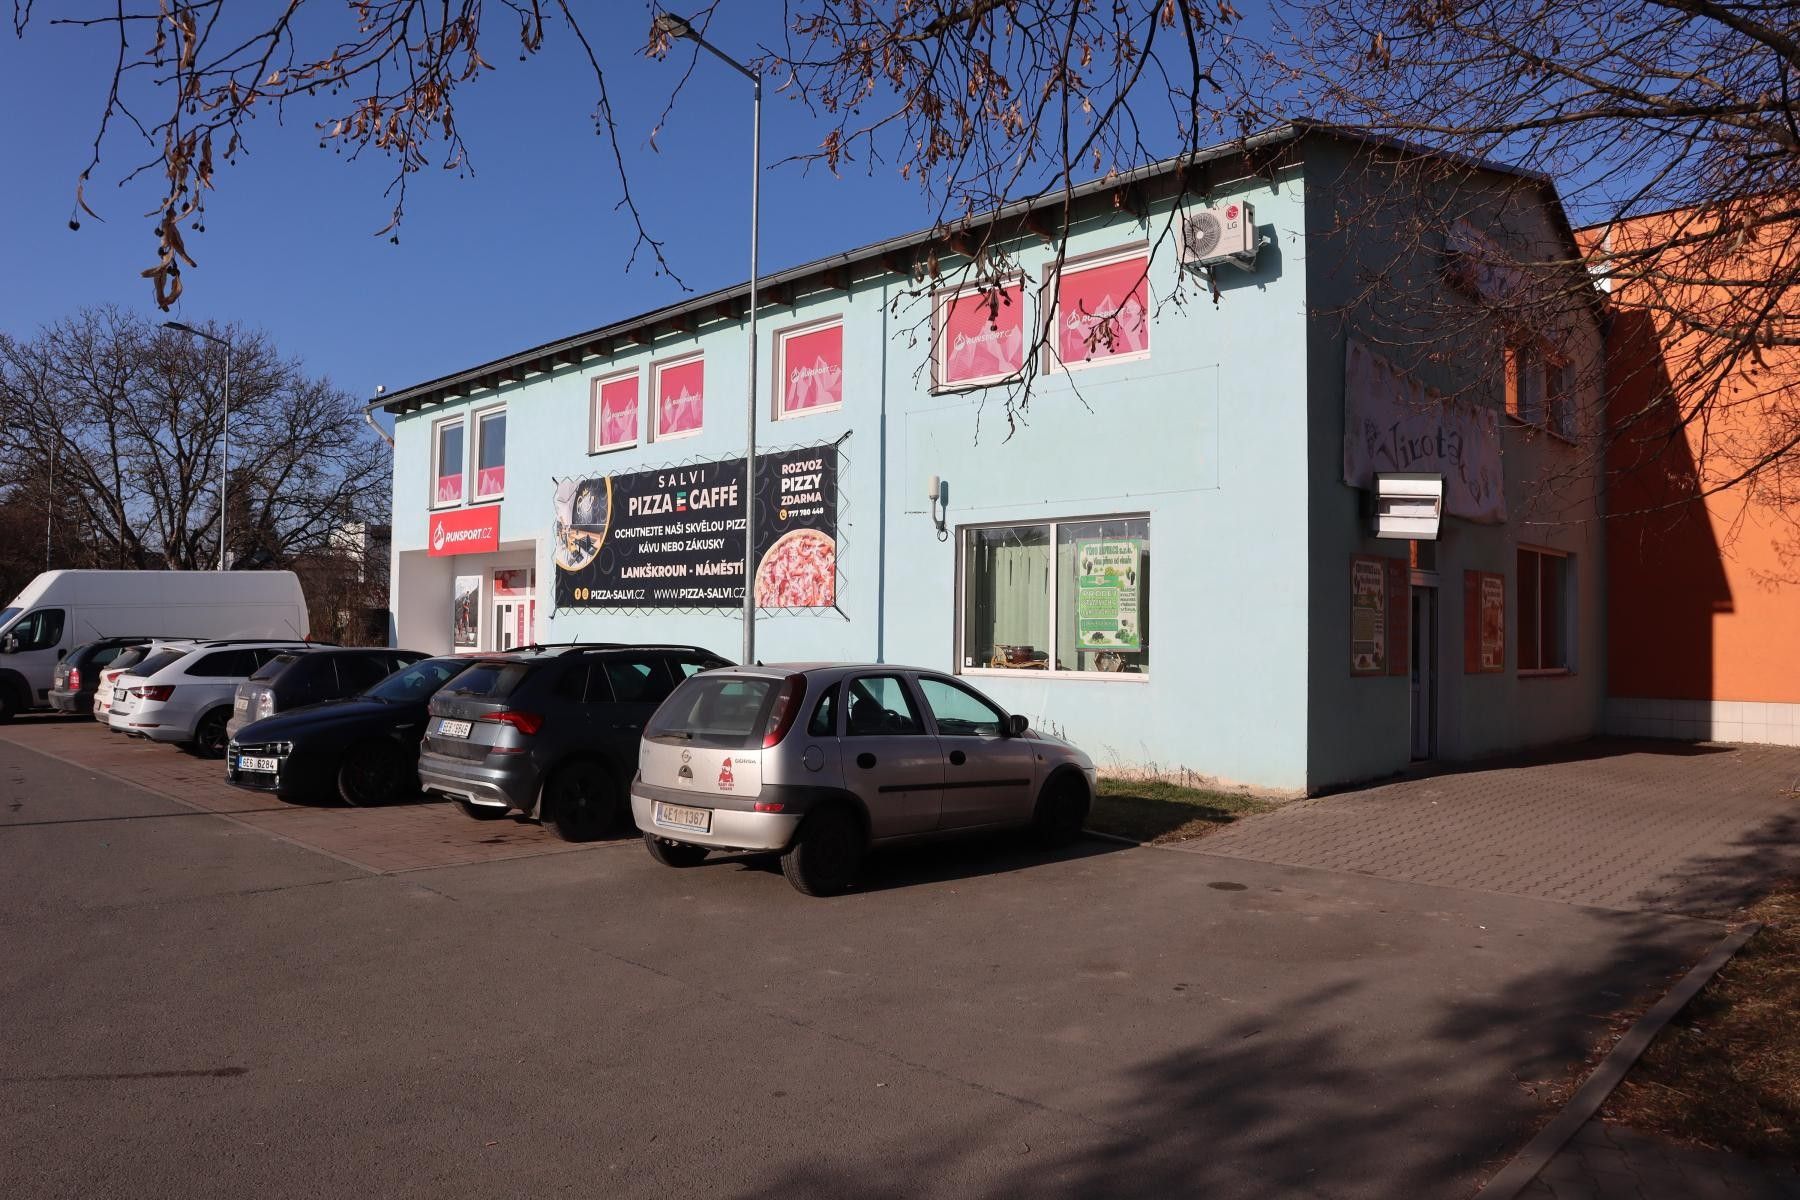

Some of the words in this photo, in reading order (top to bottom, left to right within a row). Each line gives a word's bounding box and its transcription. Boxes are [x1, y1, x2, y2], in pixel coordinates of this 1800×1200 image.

[1227, 221, 1238, 230] LG
[781, 459, 823, 475] ROZVOZ
[658, 469, 705, 488] SALVI
[781, 473, 822, 493] PIZZY
[628, 494, 673, 517] PIZZA
[689, 479, 738, 510] CAFFÉ
[781, 491, 823, 506] ZDARMA
[445, 527, 492, 543] RUNSPORT.CZ
[614, 525, 664, 539] OCHUTNEJTE
[664, 522, 684, 536] NAŠI
[685, 519, 724, 534] SKVĚLOU
[726, 518, 747, 531] PIZZ
[638, 541, 660, 554] KÁVU
[661, 540, 684, 553] NEBO
[685, 537, 725, 551] ZÁKUSKY
[621, 562, 687, 579] LANKŠKROUN
[695, 558, 745, 576] NÁMĚSTÍ
[590, 589, 646, 600] PIZZA-SALVI.CZ
[653, 587, 746, 600] WWW.PIZZA-SALVI.CZ
[663, 807, 679, 822] 4E1
[684, 810, 705, 826] 1367
